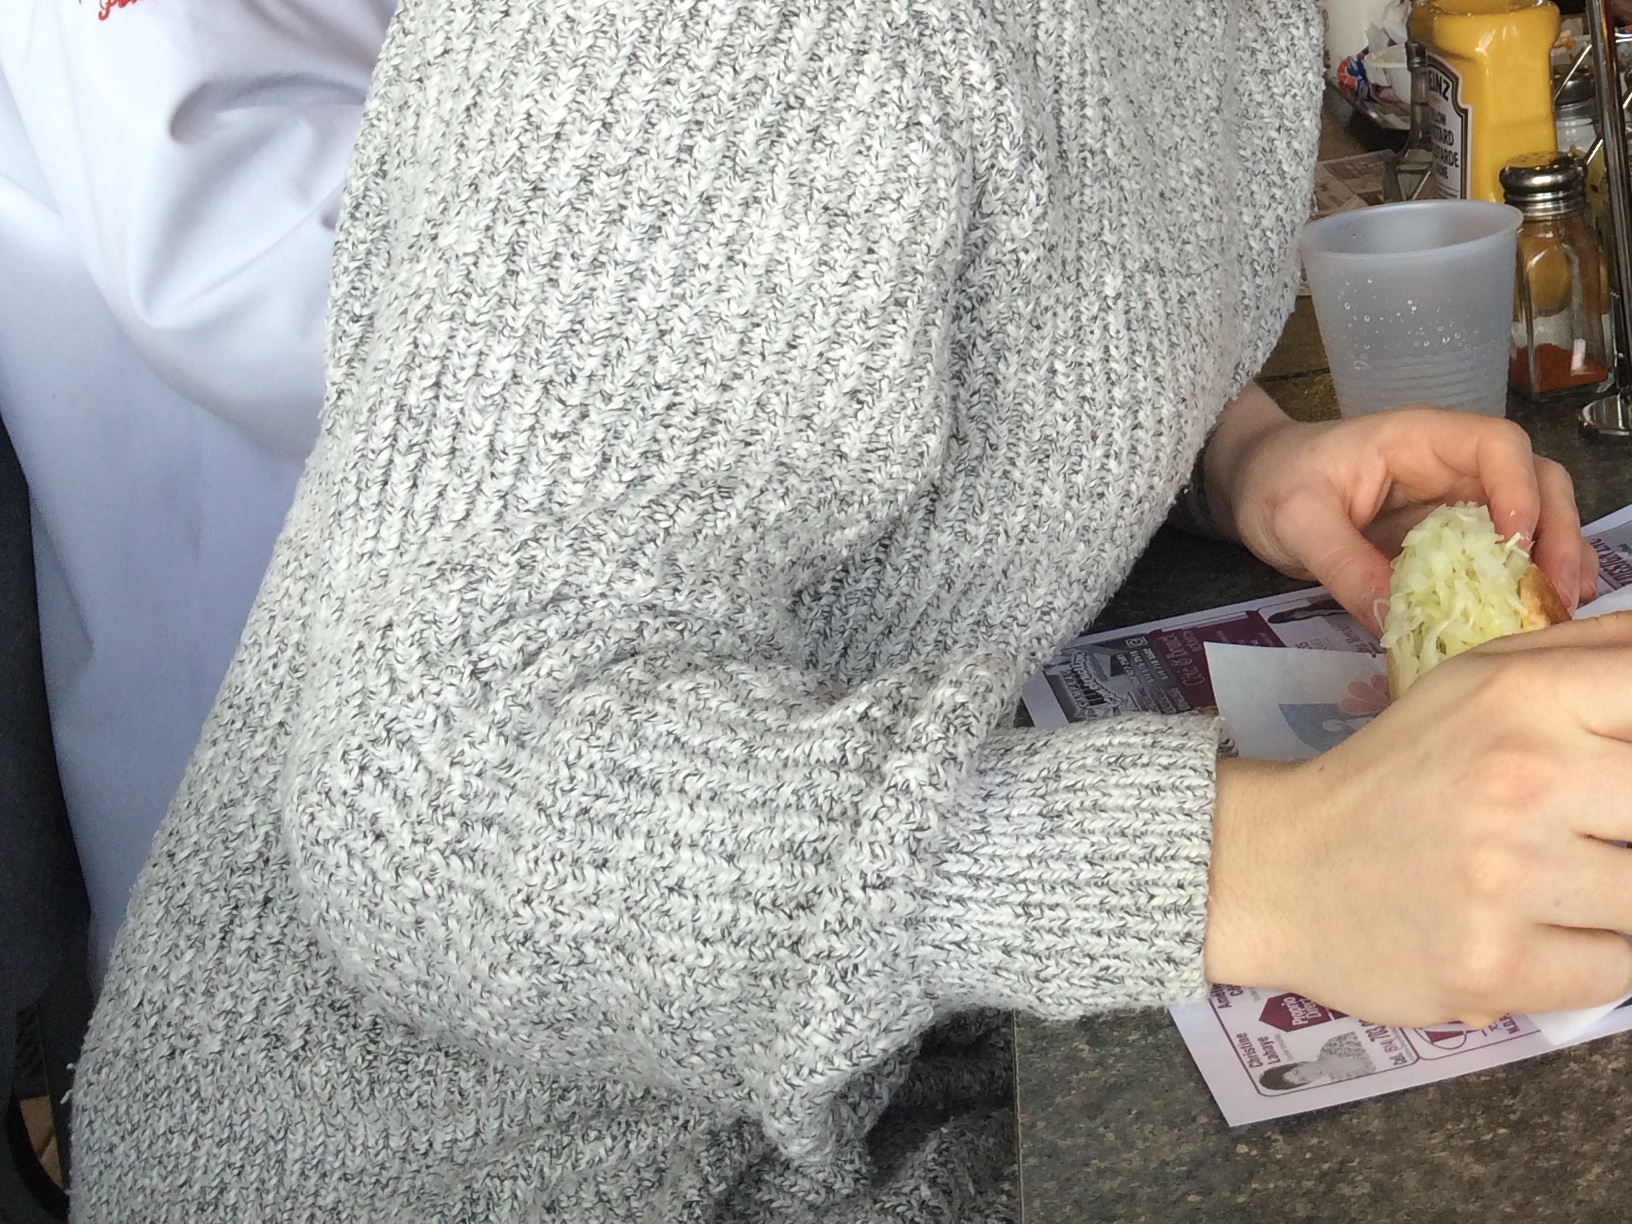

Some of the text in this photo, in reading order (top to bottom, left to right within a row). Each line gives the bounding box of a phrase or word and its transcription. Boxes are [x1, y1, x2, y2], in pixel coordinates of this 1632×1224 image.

[1283, 996, 1310, 1027] Proprio
[1236, 1032, 1264, 1069] Christine
[1257, 1036, 1282, 1066] Lahaye
